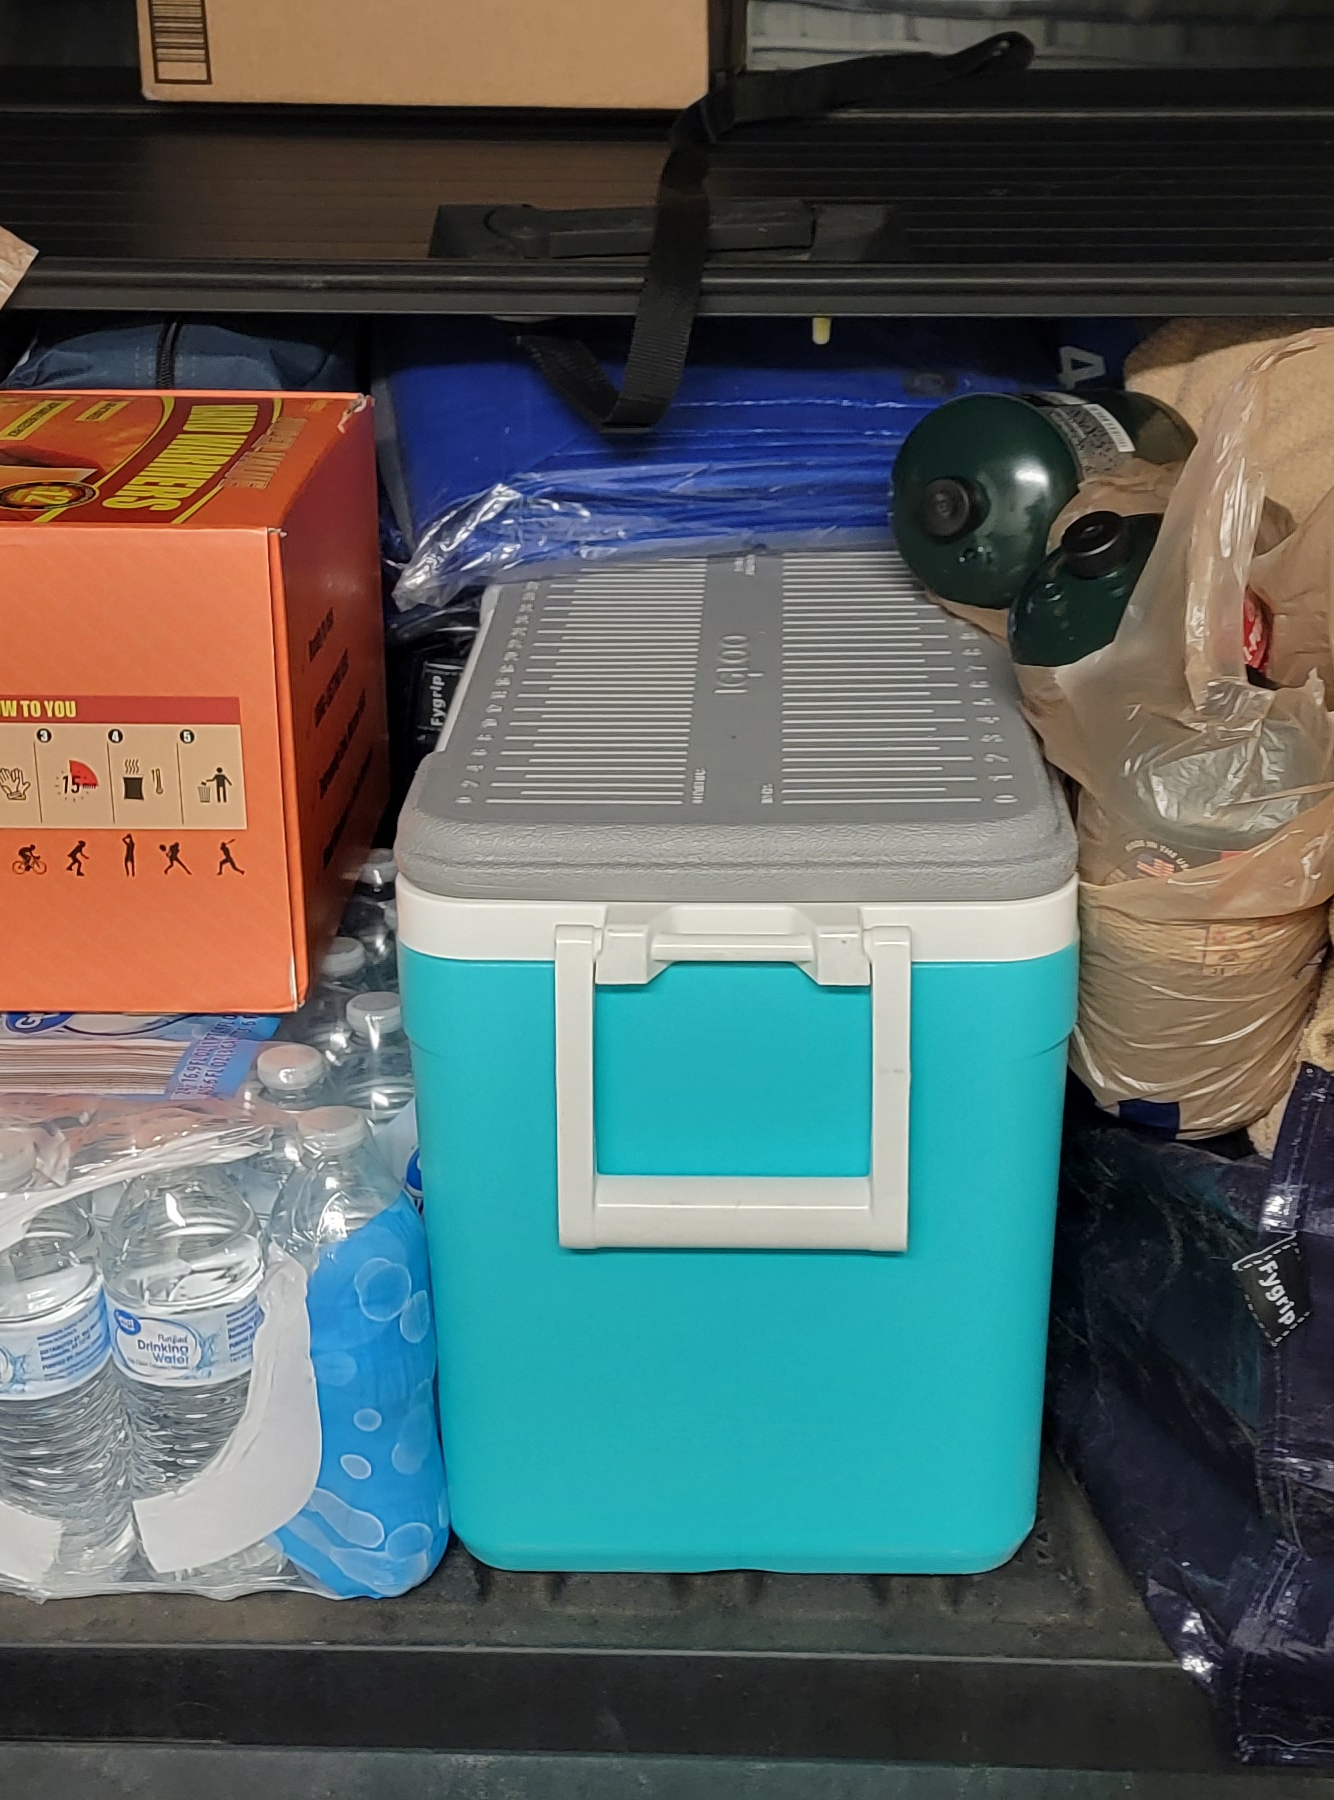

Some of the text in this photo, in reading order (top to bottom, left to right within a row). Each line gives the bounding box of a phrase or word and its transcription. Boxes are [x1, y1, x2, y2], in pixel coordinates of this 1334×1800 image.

[102, 404, 259, 511] HAND WARMERS
[429, 675, 447, 726] Fygrip
[20, 701, 41, 718] TO
[44, 701, 77, 718] YOU
[63, 775, 80, 794] 15
[188, 1057, 207, 1065] FL
[180, 1066, 202, 1082] 16.9
[204, 1069, 224, 1077] FL
[1258, 1260, 1295, 1325] Fygrip
[138, 1339, 189, 1354] Drinking
[152, 1351, 189, 1365] Water
